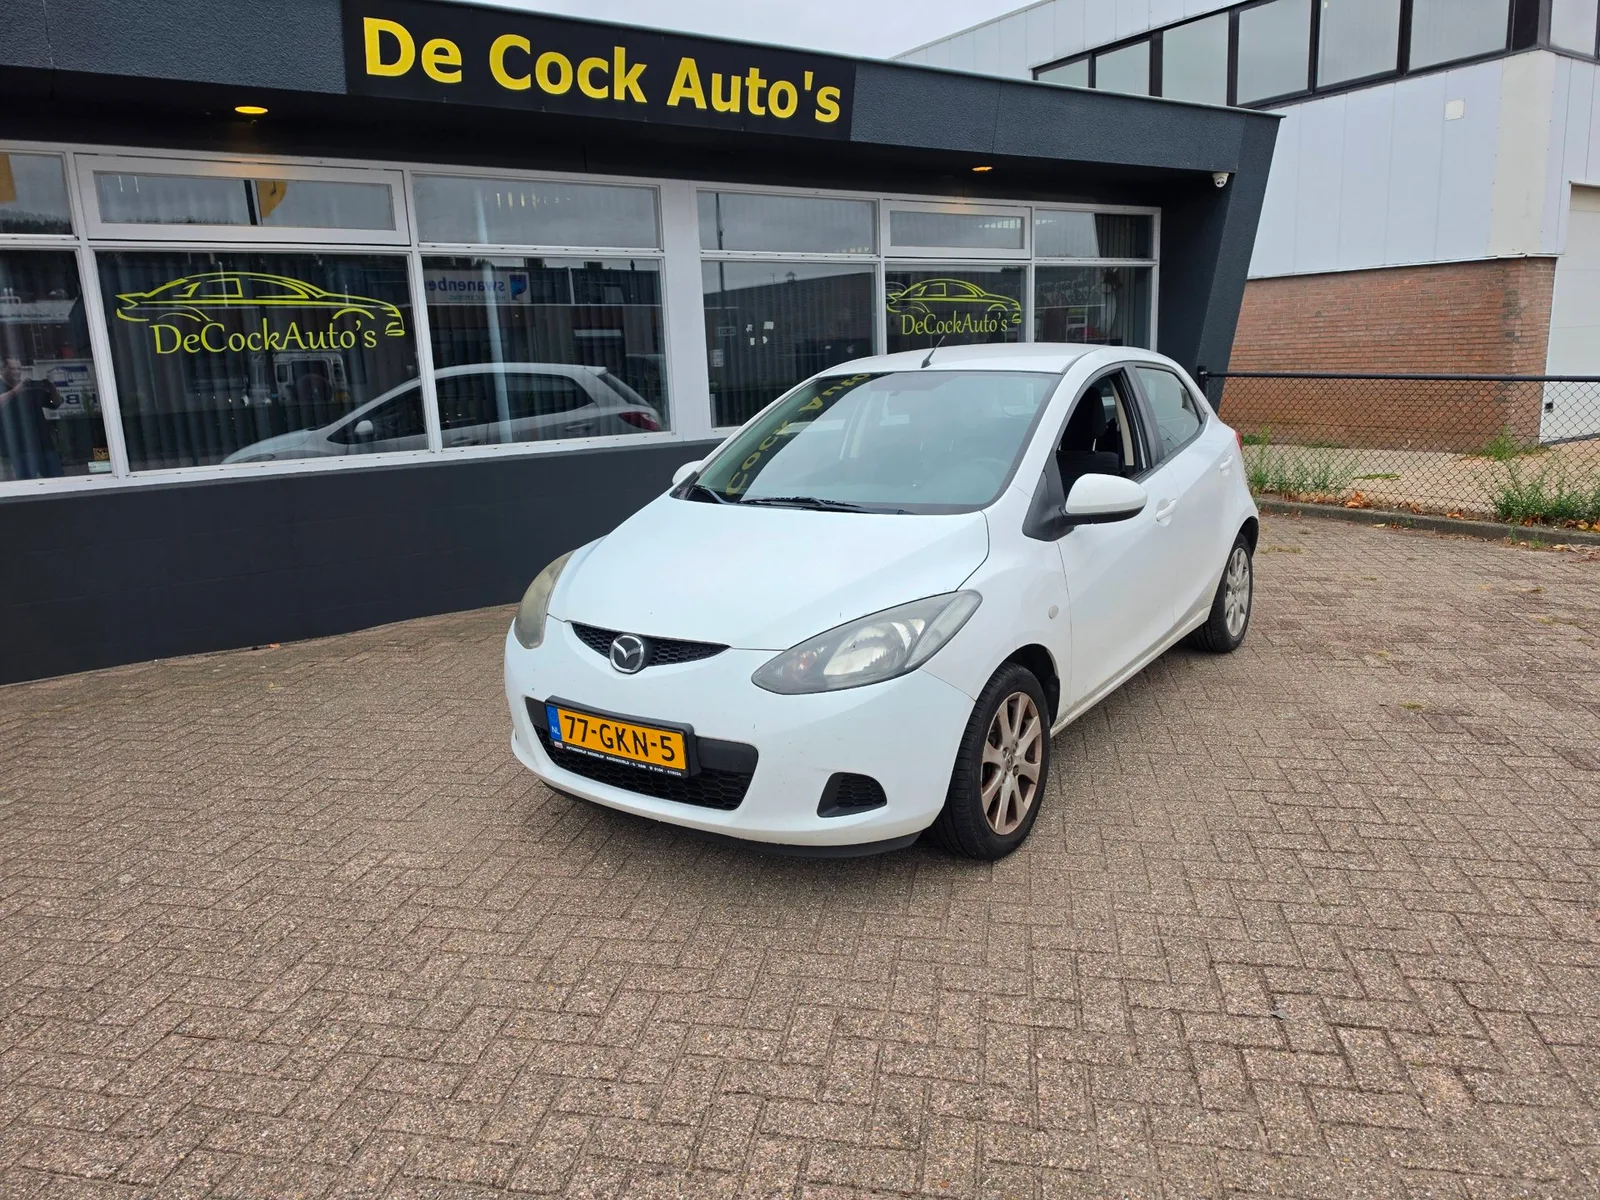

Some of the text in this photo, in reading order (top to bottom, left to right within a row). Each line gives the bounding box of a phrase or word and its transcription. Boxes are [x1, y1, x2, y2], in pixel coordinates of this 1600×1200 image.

[363, 16, 841, 123] De Cock Auto's
[150, 317, 377, 355] DeCockAuto's
[901, 309, 1008, 336] DeCockAuto's
[551, 725, 561, 735] NL
[564, 714, 676, 763] 77-GKN-5
